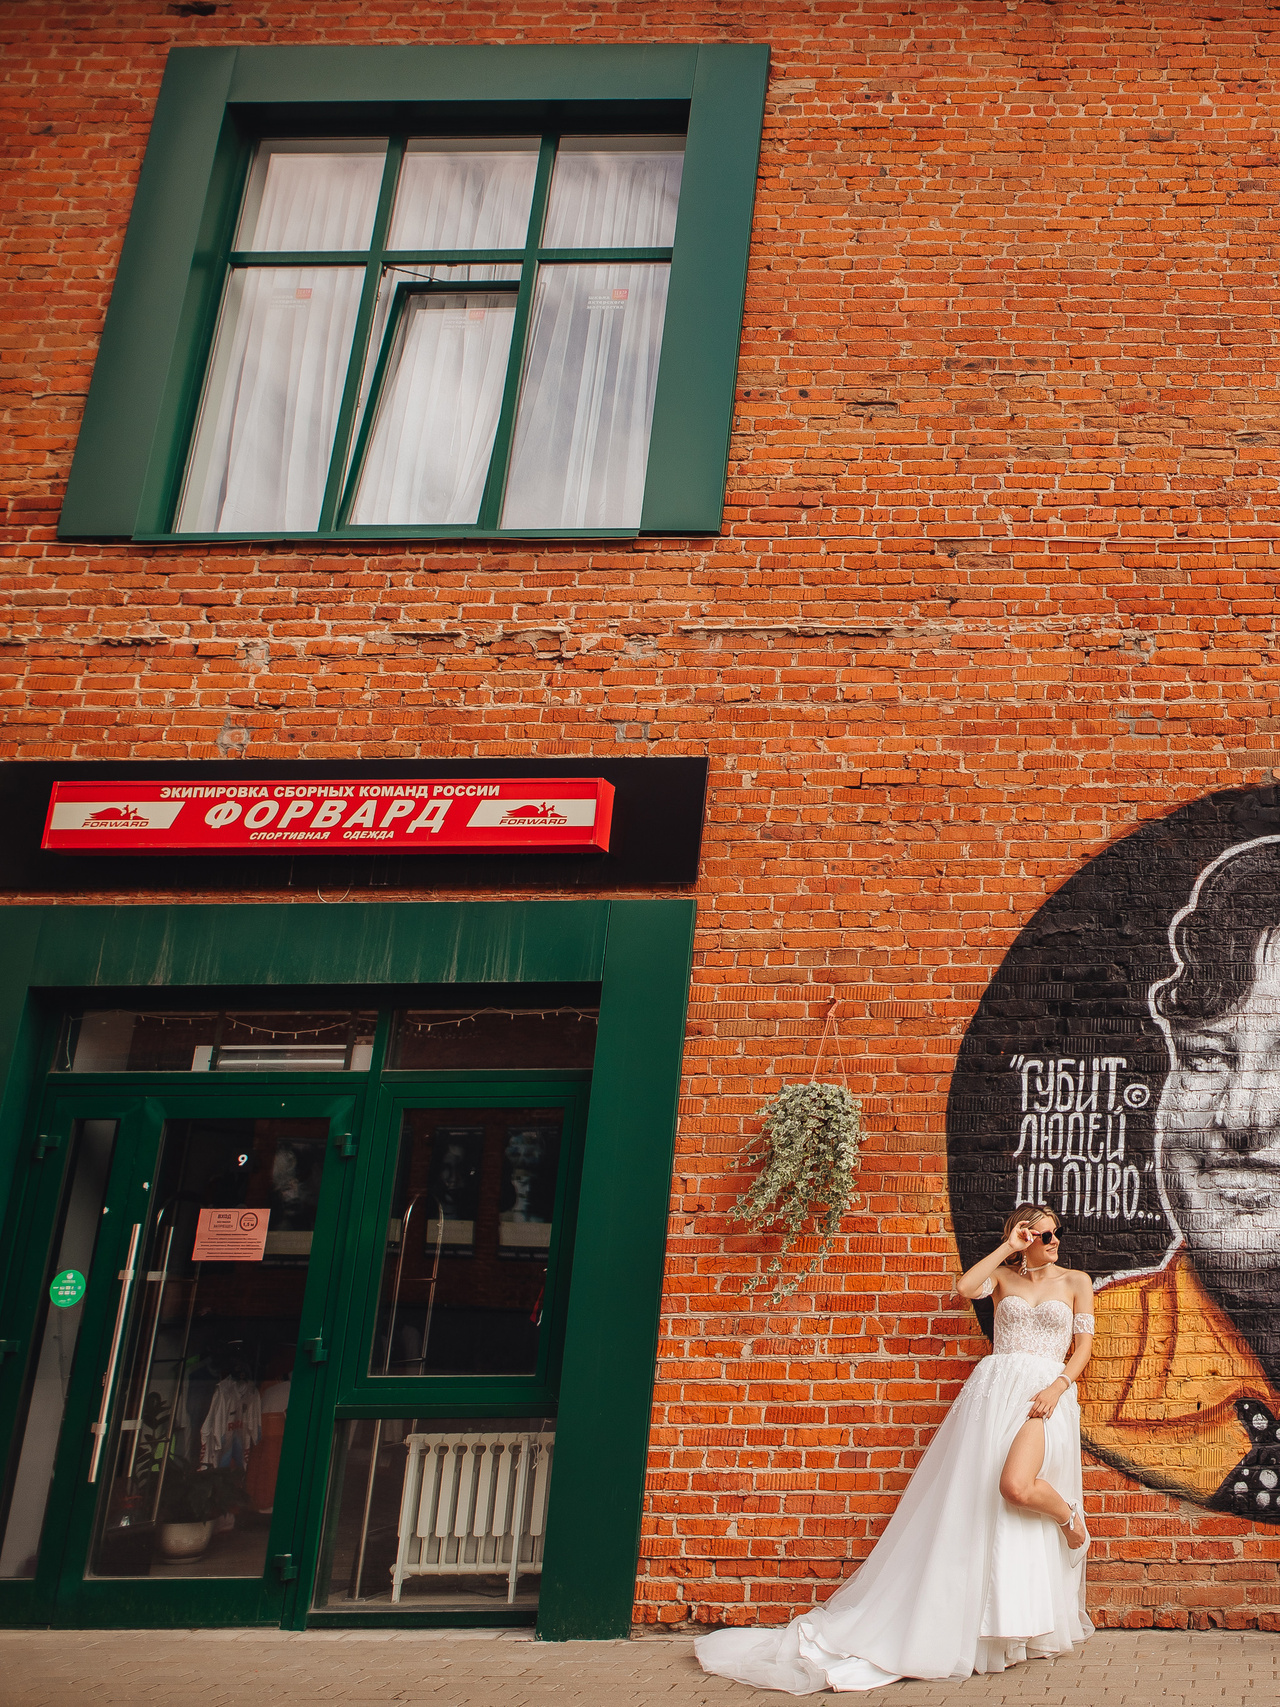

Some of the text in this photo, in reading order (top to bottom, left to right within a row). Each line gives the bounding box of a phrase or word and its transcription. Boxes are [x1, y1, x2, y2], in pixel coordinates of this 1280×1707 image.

[159, 785, 500, 799] ЭКИПИРОВКА СБОРНЫХ КОМАНД РОССИИ
[203, 799, 454, 833] ФОРВАРД
[81, 820, 150, 828] FORWARD
[248, 829, 395, 841] СПОРТИВНАЯ ОДЕЖДА
[1013, 1105, 1127, 1163] ЛЮДЕЙ
[237, 1153, 249, 1167] 9
[1015, 1162, 1054, 1207] НЕ
